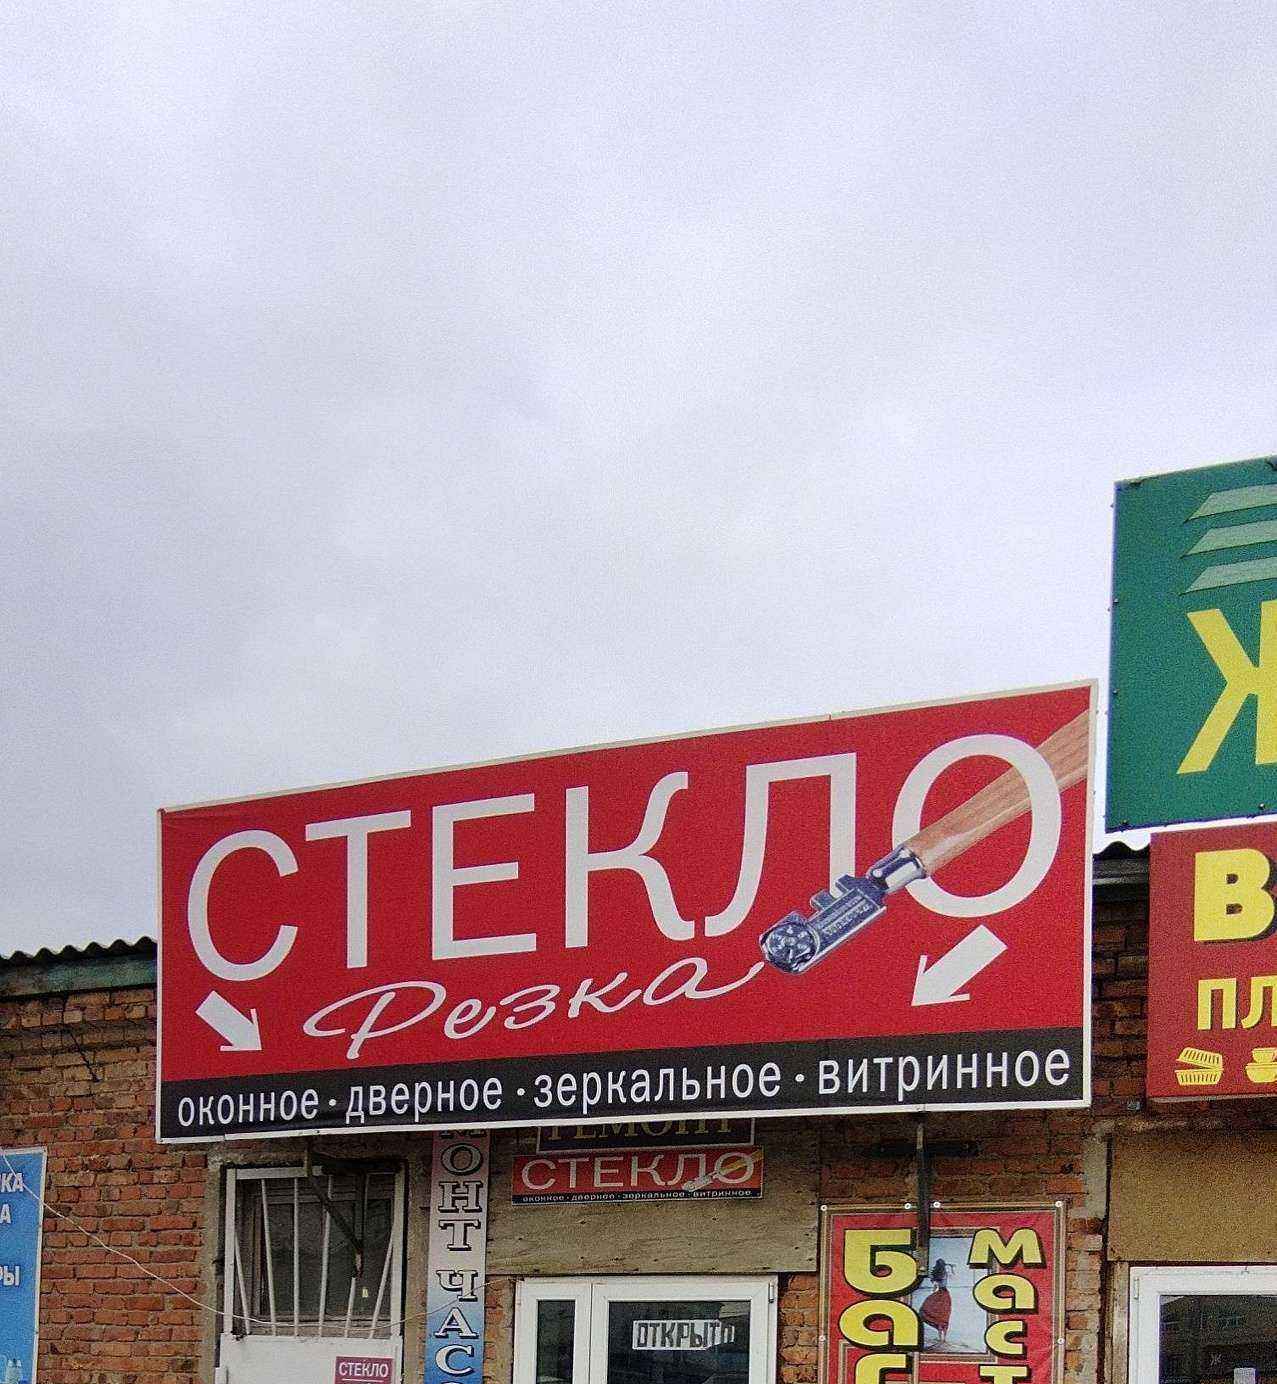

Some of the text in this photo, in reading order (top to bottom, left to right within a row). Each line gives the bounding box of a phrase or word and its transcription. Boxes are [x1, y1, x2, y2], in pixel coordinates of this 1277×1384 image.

[187, 734, 1063, 984] СТЕКЛО
[303, 956, 764, 1060] Резка
[178, 1049, 1070, 1127] оконное дверное зеркальное витринное
[438, 1130, 486, 1251] ОНТ
[521, 1151, 754, 1190] СТЕКЛО
[693, 1189, 752, 1199] витринное
[339, 1362, 389, 1377] СТЕКЛО
